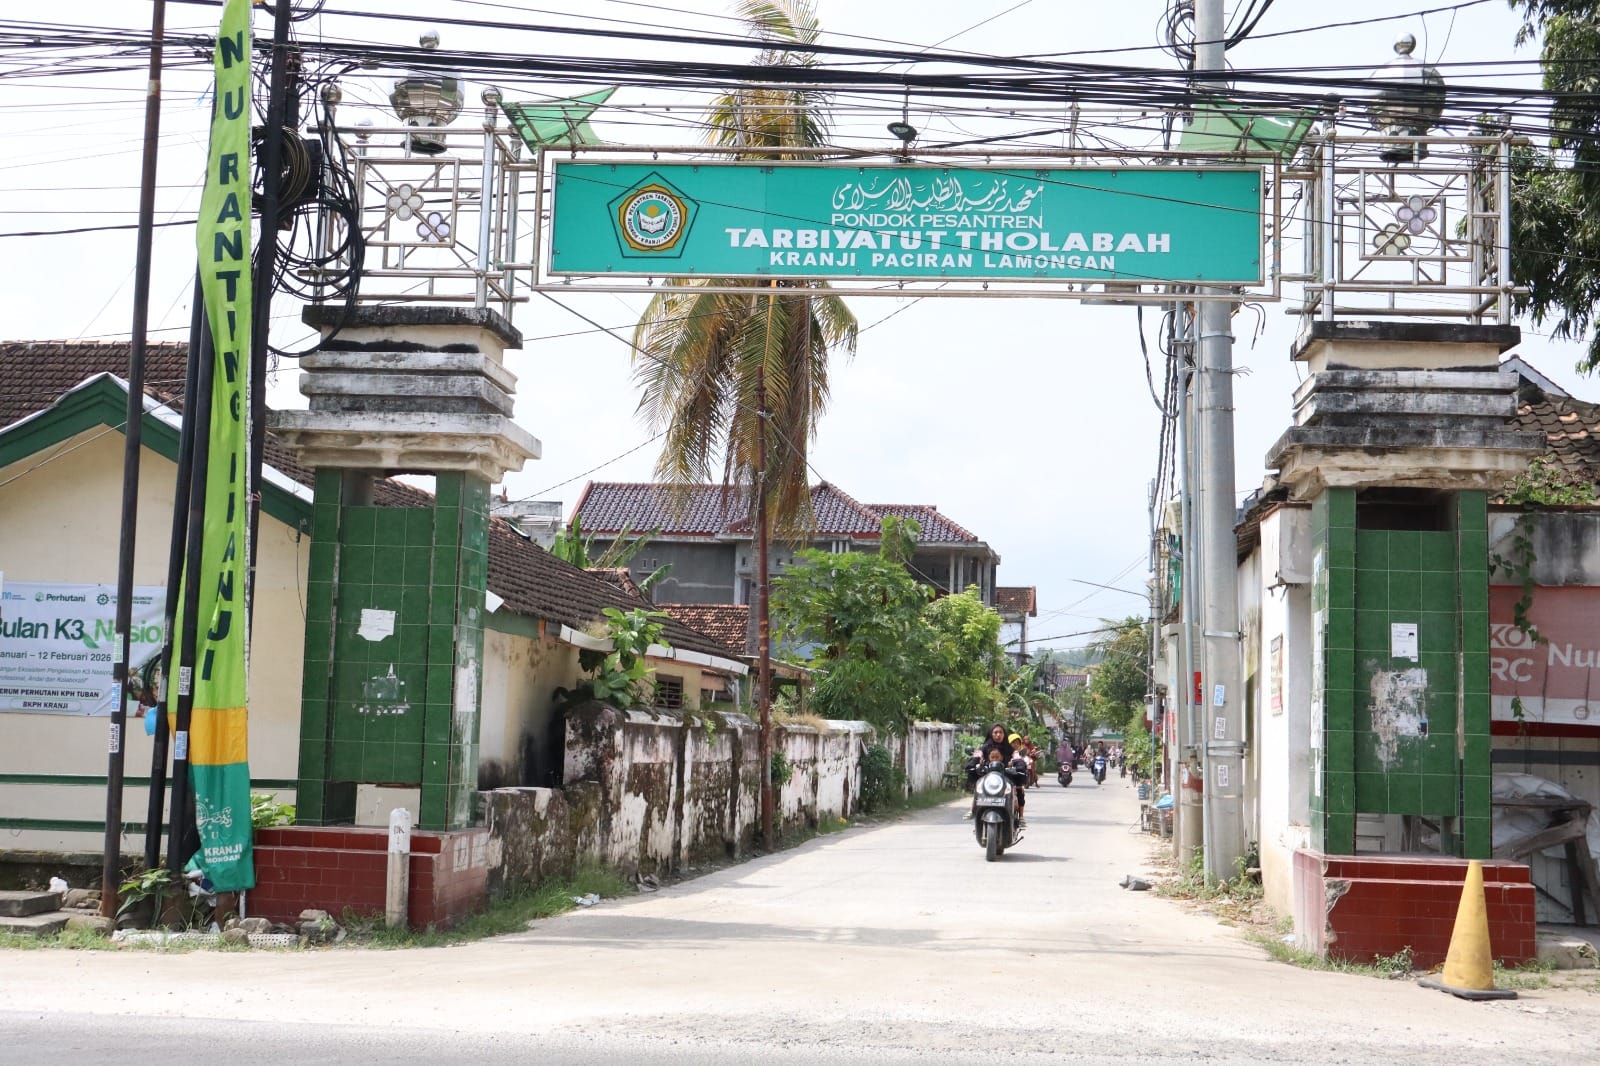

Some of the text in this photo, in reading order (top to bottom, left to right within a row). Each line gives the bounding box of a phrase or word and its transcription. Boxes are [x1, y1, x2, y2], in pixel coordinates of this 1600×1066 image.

[831, 213, 1043, 229] PONDOK PESANTREN
[725, 228, 1171, 253] TARBIYATUT THOLABAH
[770, 252, 1115, 270] KRANJI PACIRAN LAMONGAN
[46, 593, 86, 602] Perhutani
[54, 618, 85, 640] K3
[95, 619, 164, 644] Nsio
[38, 651, 48, 660] 12
[50, 651, 88, 661] Februari
[90, 653, 112, 662] 2026
[1548, 643, 1600, 668] Nu
[20, 688, 59, 697] PERHUTANI
[60, 689, 75, 697] KPH
[77, 690, 99, 698] TUBAN
[204, 843, 243, 857] KRANJI
